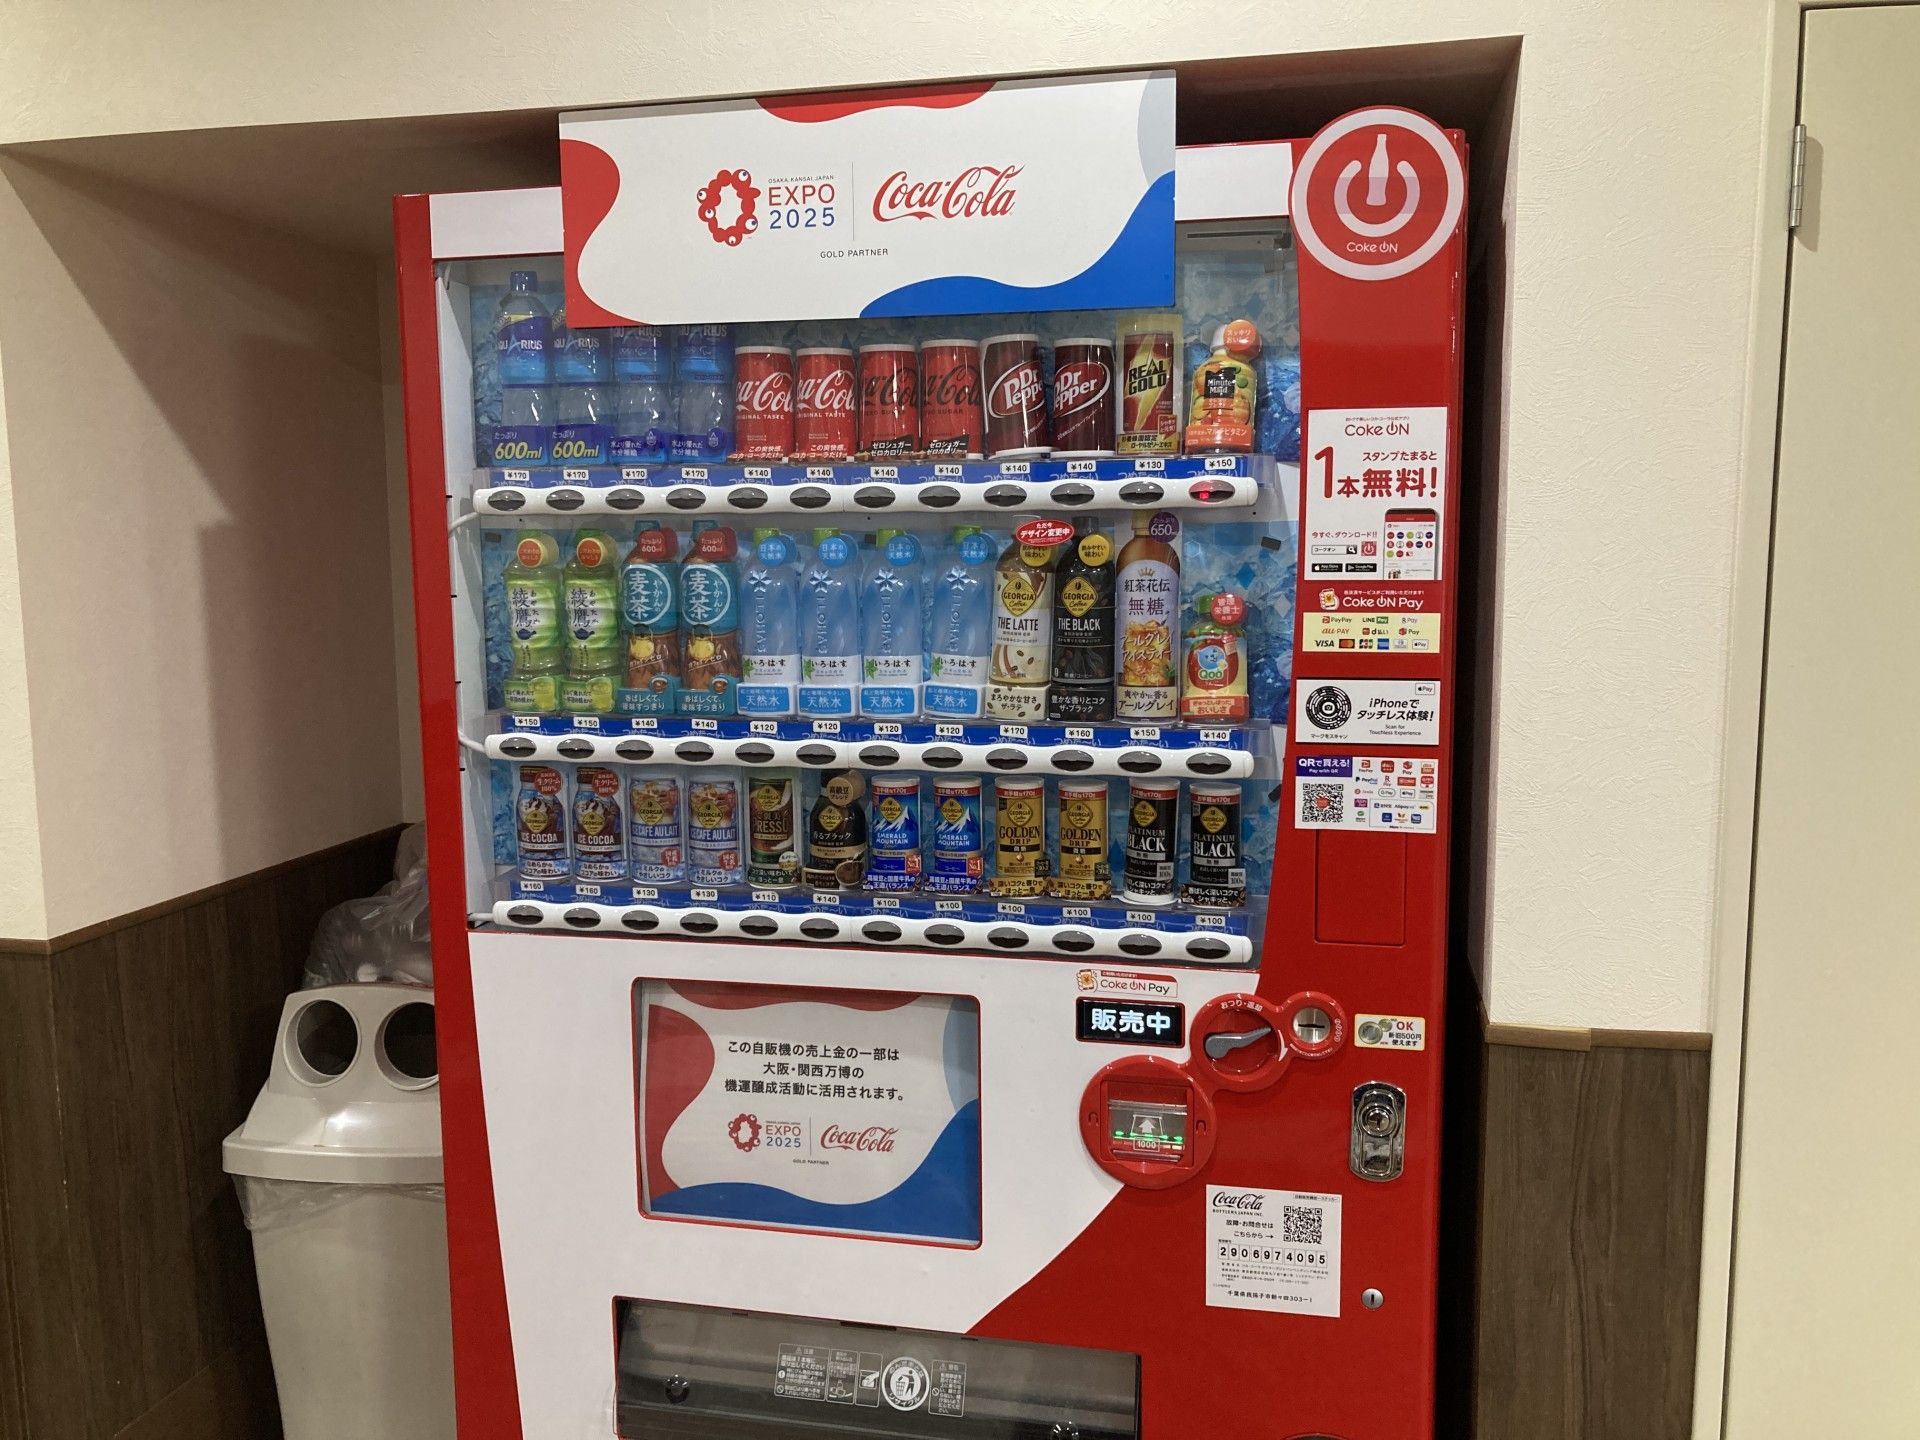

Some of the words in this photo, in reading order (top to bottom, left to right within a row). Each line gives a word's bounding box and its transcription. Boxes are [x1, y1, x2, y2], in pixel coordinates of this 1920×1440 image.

[768, 183, 835, 206] EXPO
[872, 163, 1026, 223] Coca-Cola
[769, 207, 835, 229] 2025
[1346, 241, 1377, 253] Coke
[1379, 240, 1398, 254] ON
[820, 250, 844, 259] GOLD
[848, 247, 889, 257] PARTNER
[1128, 358, 1167, 383] REAL
[1019, 368, 1038, 389] Dr
[1060, 371, 1082, 391] Dr
[1207, 378, 1232, 387] Minute
[1128, 372, 1167, 396] GOLD
[1209, 386, 1228, 394] Maid
[1344, 424, 1383, 436] Coke
[1386, 421, 1409, 436] ON
[494, 441, 542, 459] 600ml
[552, 440, 599, 459] 600ml
[872, 441, 912, 449] ゼロシュガー
[1362, 451, 1438, 462] スタンプたまると
[1005, 463, 1028, 473] ¥140
[1070, 462, 1093, 471] ¥140
[1138, 460, 1162, 469] ¥130
[1208, 458, 1232, 468] ¥150
[508, 471, 527, 480] ¥170
[566, 470, 587, 479] ¥170
[625, 469, 645, 478] ¥170
[684, 469, 705, 478] ¥170
[747, 469, 769, 477] ¥140
[809, 468, 831, 477] ¥140
[874, 468, 895, 476] ¥140
[938, 466, 960, 475] ¥140
[1314, 446, 1438, 499] 1本無料!
[1020, 528, 1070, 538] デザイン変更中
[1124, 578, 1171, 593] 紅茶花伝
[629, 570, 653, 620] 麦茶
[688, 570, 712, 620] 麦茶
[1003, 592, 1034, 601] GEORGIA
[1063, 592, 1095, 601] GEORGIA
[1128, 597, 1165, 616] 無糖
[1342, 596, 1375, 608] Coke
[1376, 595, 1396, 608] ON
[1399, 597, 1424, 611] Pay
[1214, 606, 1240, 615] 栄養士
[997, 616, 1012, 630] THE
[1013, 618, 1039, 631] LATTE
[1058, 618, 1071, 630] THE
[1072, 618, 1101, 631] BLACK
[1315, 639, 1335, 647] VISA
[629, 654, 662, 668] カフェインゼロ
[688, 654, 722, 669] カフェインゼロ
[1199, 669, 1223, 679] Qoo
[990, 693, 1037, 703] まろやかな甘さ
[1124, 689, 1168, 699] 爽やかに香る
[746, 695, 780, 706] 天然水
[807, 696, 842, 708] 天然水
[870, 696, 905, 708] 天然水
[933, 694, 968, 708] 天然水
[1051, 695, 1106, 705] 豊かな香りとコク
[1369, 698, 1420, 708] iPhoneで
[622, 702, 665, 712] 後味すっきり
[681, 703, 725, 712] 後味すっきり
[1059, 704, 1094, 713] ザ・ブラック
[1118, 699, 1174, 712] アールグレイ
[1197, 705, 1227, 714] おいしさ
[1357, 710, 1434, 722] タッチレス体験!
[518, 717, 538, 726] ¥150
[577, 718, 598, 727] ¥150
[635, 719, 655, 727] ¥140
[695, 720, 715, 729] ¥140
[816, 722, 838, 731] ¥120
[753, 723, 775, 731] ¥120
[878, 725, 899, 733] ¥120
[938, 726, 960, 735] ¥120
[1003, 727, 1025, 735] ¥170
[1068, 730, 1091, 738] ¥160
[1133, 729, 1156, 737] ¥150
[1204, 732, 1227, 740] ¥140
[1298, 758, 1350, 768] QRで買える!
[999, 825, 1041, 839] GOLDEN
[1060, 828, 1102, 841] GOLDEN
[1193, 832, 1235, 841] PLATINUM
[1127, 833, 1166, 852] BLACK
[1193, 841, 1236, 857] BLACK
[523, 882, 542, 890] ¥160
[579, 886, 599, 895] ¥160
[873, 882, 909, 890] 王道バランス
[935, 883, 971, 891] 王道バランス
[1006, 886, 1036, 894] ほっと一息
[695, 890, 715, 898] ¥130
[1064, 888, 1096, 896] ほっと一息
[1188, 887, 1239, 897] 香ばしく深いコクで
[754, 894, 776, 902] ¥110
[816, 895, 837, 904] ¥140
[1066, 908, 1088, 916] ¥100
[1130, 913, 1152, 921] ¥100
[1199, 916, 1223, 925] ¥100
[1100, 979, 1128, 989] Coke
[1129, 980, 1146, 991] ON
[1148, 983, 1170, 995] Pay
[1220, 999, 1263, 1012] おつり・返却
[1091, 1008, 1171, 1035] 販売中
[1396, 1021, 1414, 1031] OK
[1388, 1032, 1422, 1041] 新旧500円
[1392, 1039, 1418, 1047] 使えます
[728, 1040, 900, 1062] この自販機の売上金の一部は
[762, 1062, 864, 1079] 大阪・関西万博の
[724, 1078, 904, 1102] 機運醸成活動に活用されます。
[765, 1125, 801, 1137] EXPO
[766, 1136, 801, 1148] 2025
[820, 1124, 901, 1153] Coca-Cola
[1137, 1140, 1157, 1149] 1000
[1212, 1191, 1266, 1211] Coca-Cola
[1225, 1219, 1274, 1229] 故障・お問合せは
[1233, 1231, 1263, 1239] こちらから
[1220, 1246, 1326, 1265] 2906974095
[888, 1391, 921, 1408] リサイクル
